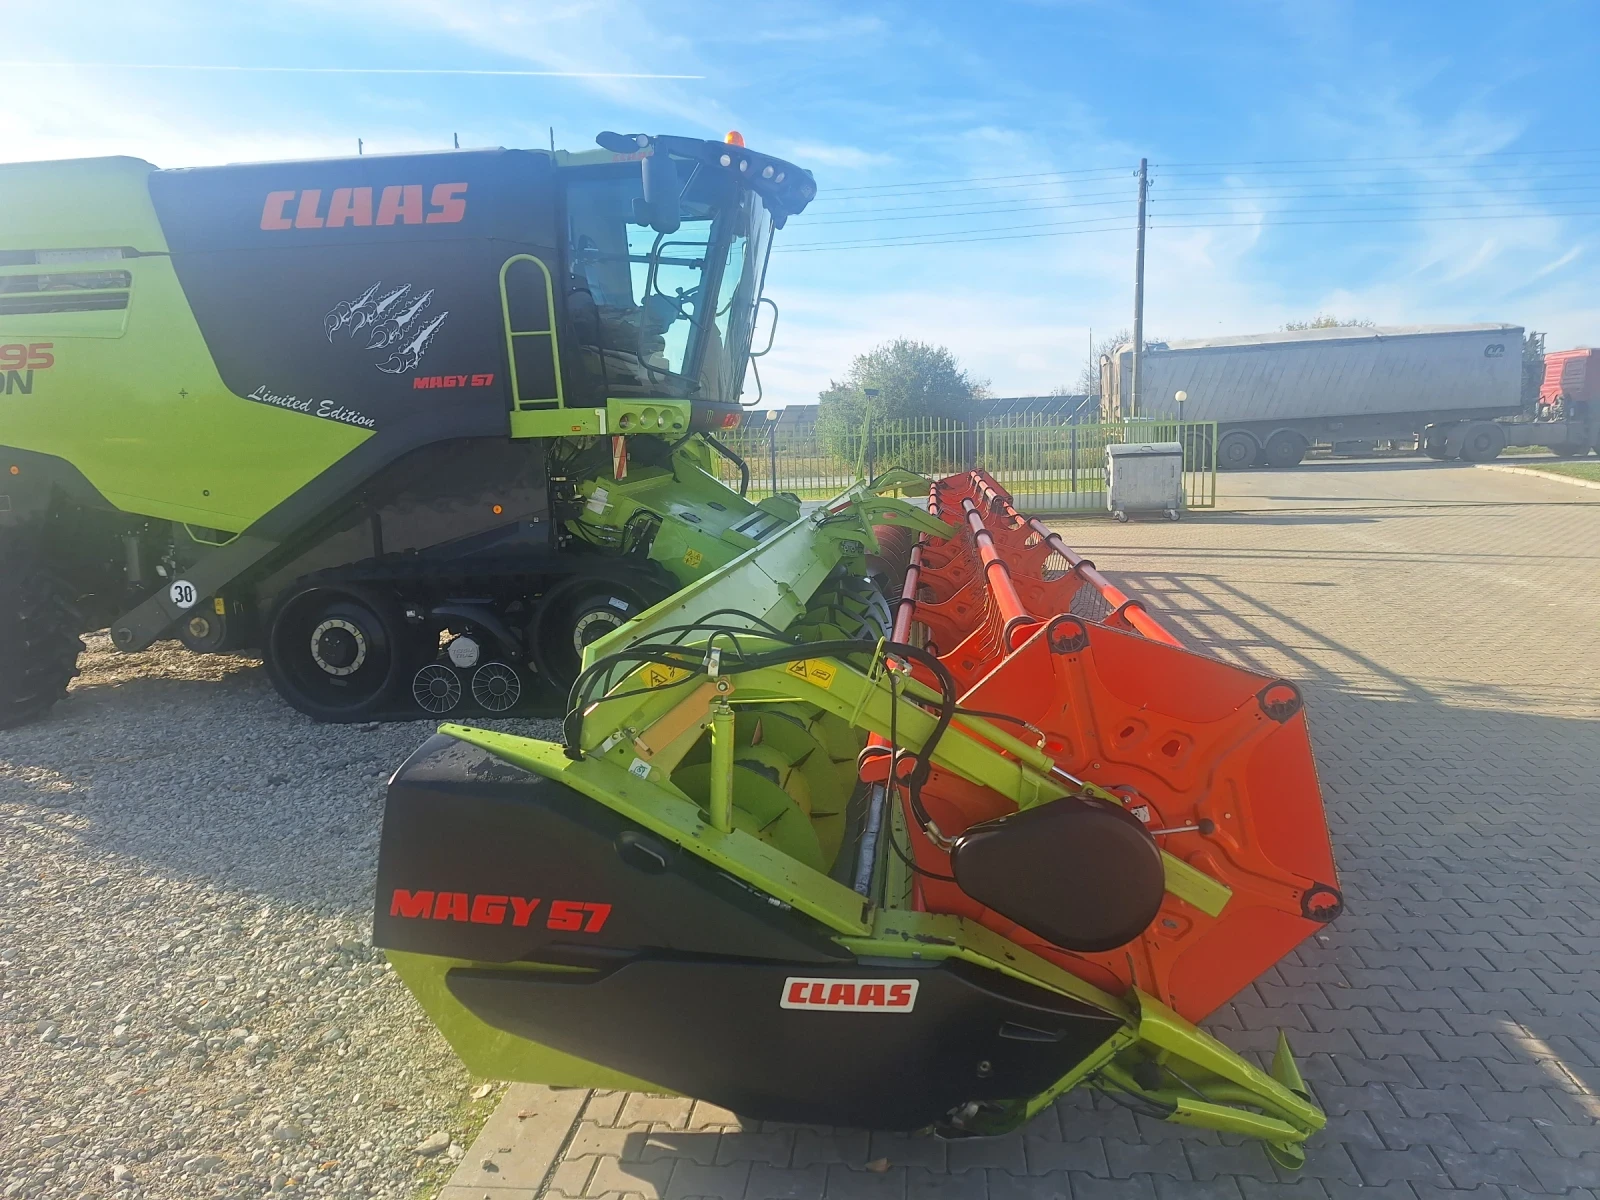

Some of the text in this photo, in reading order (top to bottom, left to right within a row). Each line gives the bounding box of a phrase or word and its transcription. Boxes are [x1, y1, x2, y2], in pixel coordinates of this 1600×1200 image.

[260, 182, 468, 231] CLAAS
[0, 342, 55, 370] 95
[0, 369, 34, 395] N
[413, 373, 494, 389] MAGY 57
[247, 384, 375, 427] Limited Edition
[174, 585, 193, 603] 30
[389, 888, 612, 933] MAGY 57
[787, 982, 912, 1006] CLAAS
